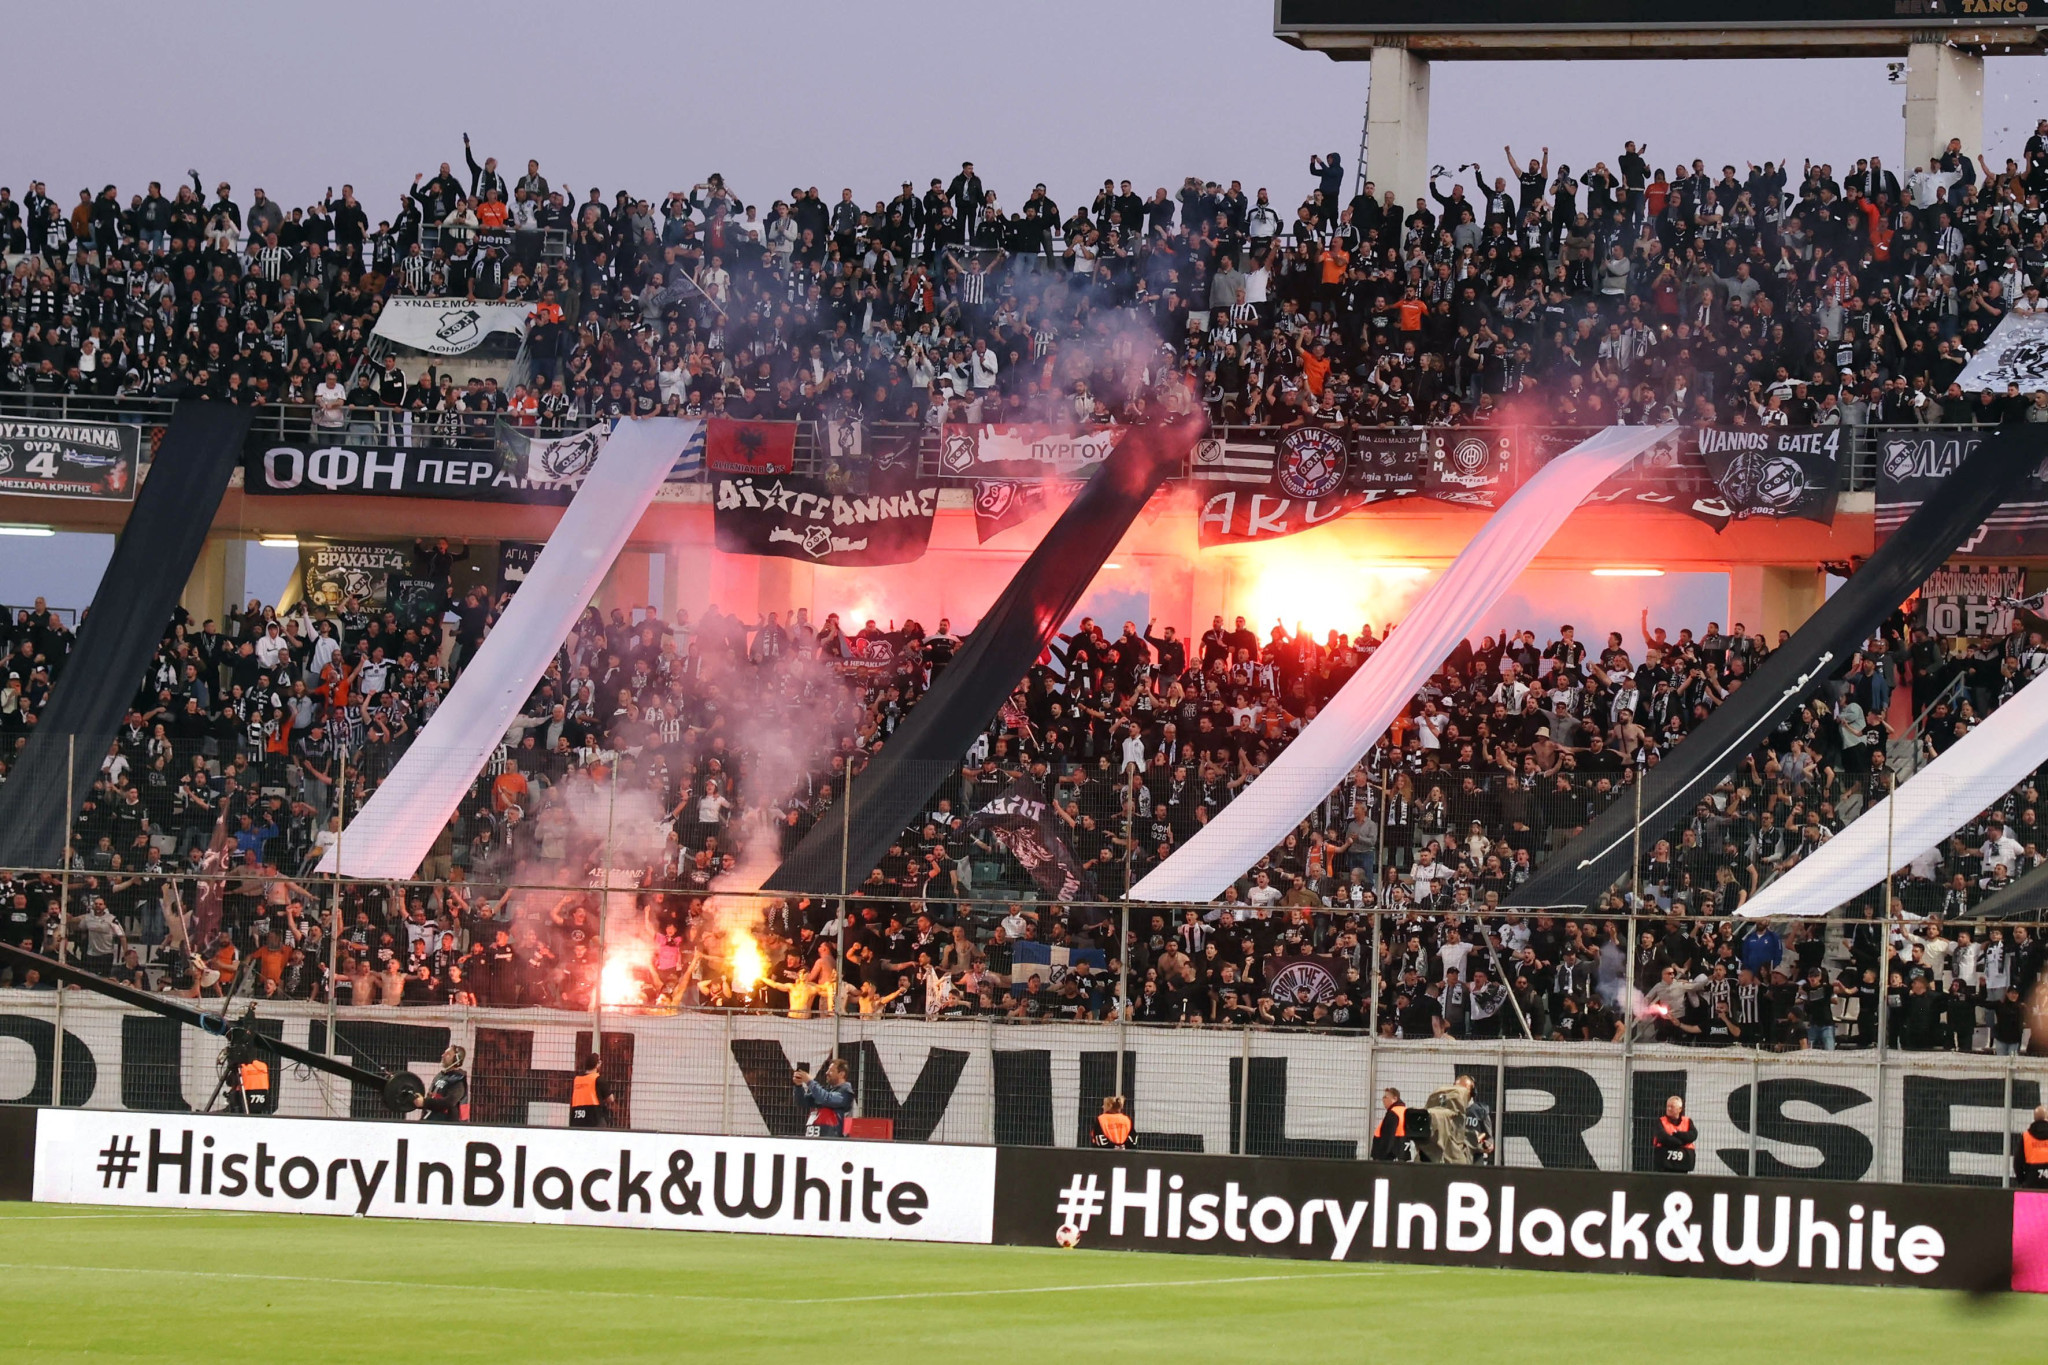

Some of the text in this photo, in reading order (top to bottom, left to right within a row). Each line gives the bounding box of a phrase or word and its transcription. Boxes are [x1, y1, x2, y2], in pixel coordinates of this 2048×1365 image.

[0, 423, 119, 449] ΥΣΤΟΥΛΙΑΝΑ
[1304, 429, 1321, 442] UK
[1699, 427, 1841, 462] VIANNOS GATE 4
[24, 442, 62, 453] ΘΥΡΑ
[1359, 450, 1418, 463] 19 25
[25, 452, 59, 478] 4
[263, 447, 407, 491] ΟΦΗ
[1281, 469, 1341, 496] ALWAYS ON TOUR
[1360, 471, 1413, 483] Agia Triada
[49, 482, 92, 493] ΚΡΗΤΗΣ
[1751, 506, 1775, 516] 2002
[326, 545, 346, 553] ΣΤΟ
[374, 547, 395, 555] ΣΟΥ
[505, 548, 528, 560] ΑΓΙΑ
[317, 552, 404, 571] ΒΡΑΧΑΣΙ-4
[1934, 603, 2007, 637] OFI
[1297, 966, 1321, 986] THE
[250, 1094, 266, 1104] 776
[731, 1037, 1358, 1161] WILL
[1454, 1062, 2042, 1186] RISE
[1667, 1150, 1683, 1161] 759
[97, 1129, 929, 1226] #HistoryInBlack&White
[1056, 1167, 1945, 1274] #HistoryInBlack&White
